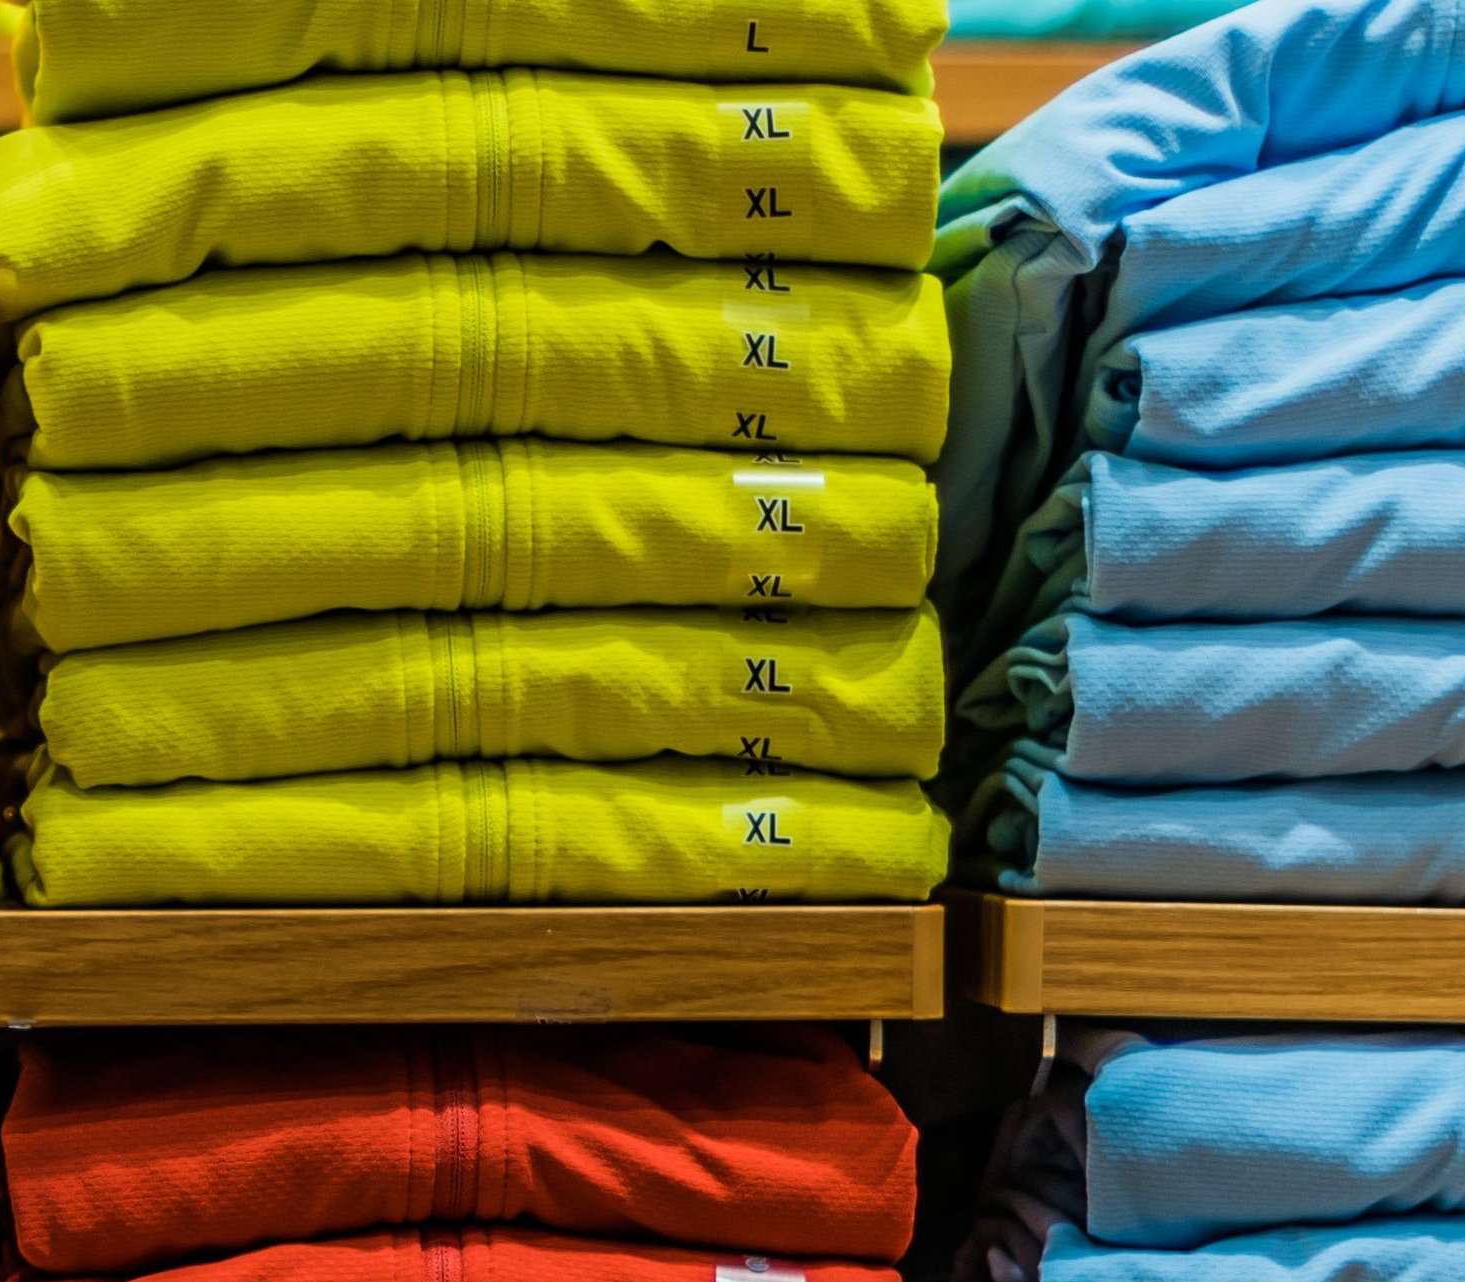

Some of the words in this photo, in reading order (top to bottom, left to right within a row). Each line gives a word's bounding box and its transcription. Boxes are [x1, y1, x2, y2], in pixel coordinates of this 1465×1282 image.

[747, 23, 769, 52] L
[743, 109, 790, 140] XL
[745, 188, 792, 218] XL
[744, 268, 790, 292] XL
[744, 333, 788, 369] XL
[733, 412, 777, 440] XL
[757, 499, 804, 533] XL
[748, 575, 792, 598] XL
[744, 659, 790, 692] XL
[737, 738, 782, 761] XL
[745, 812, 790, 845] XL
